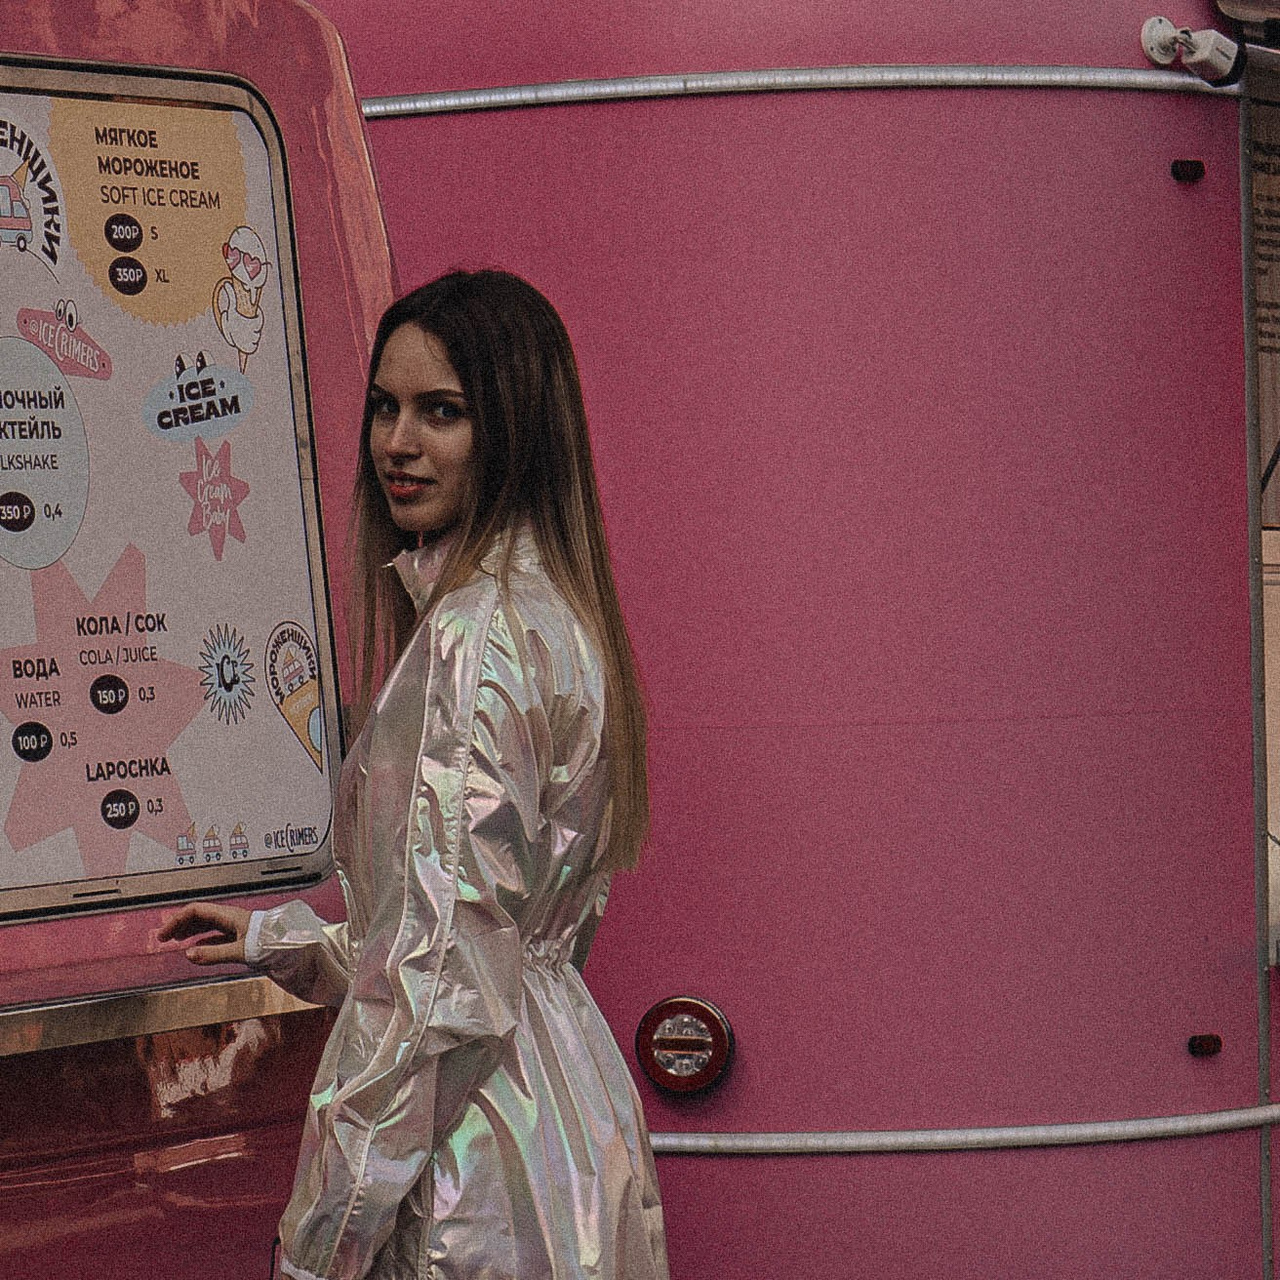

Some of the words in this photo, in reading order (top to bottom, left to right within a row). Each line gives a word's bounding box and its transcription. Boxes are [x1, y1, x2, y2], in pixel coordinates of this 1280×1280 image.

[94, 126, 159, 149] МЯГКОЕ
[97, 155, 200, 180] МОРОЖЕНОЕ
[100, 185, 138, 205] SOFT
[142, 187, 167, 207] ICE
[169, 189, 221, 210] CREAM
[150, 226, 159, 240] S
[154, 269, 170, 283] XL
[177, 377, 217, 403] ICE
[156, 395, 241, 431] CREAM
[43, 502, 64, 521] 0,4
[76, 616, 121, 637] КОЛА
[134, 612, 168, 633] СОК
[12, 657, 61, 682] ВОДА
[14, 690, 62, 710] WATER
[138, 686, 156, 705] 0,3
[59, 731, 78, 750] 0,5
[85, 756, 172, 783] LAPOCHKA
[146, 797, 164, 815] 0,3
